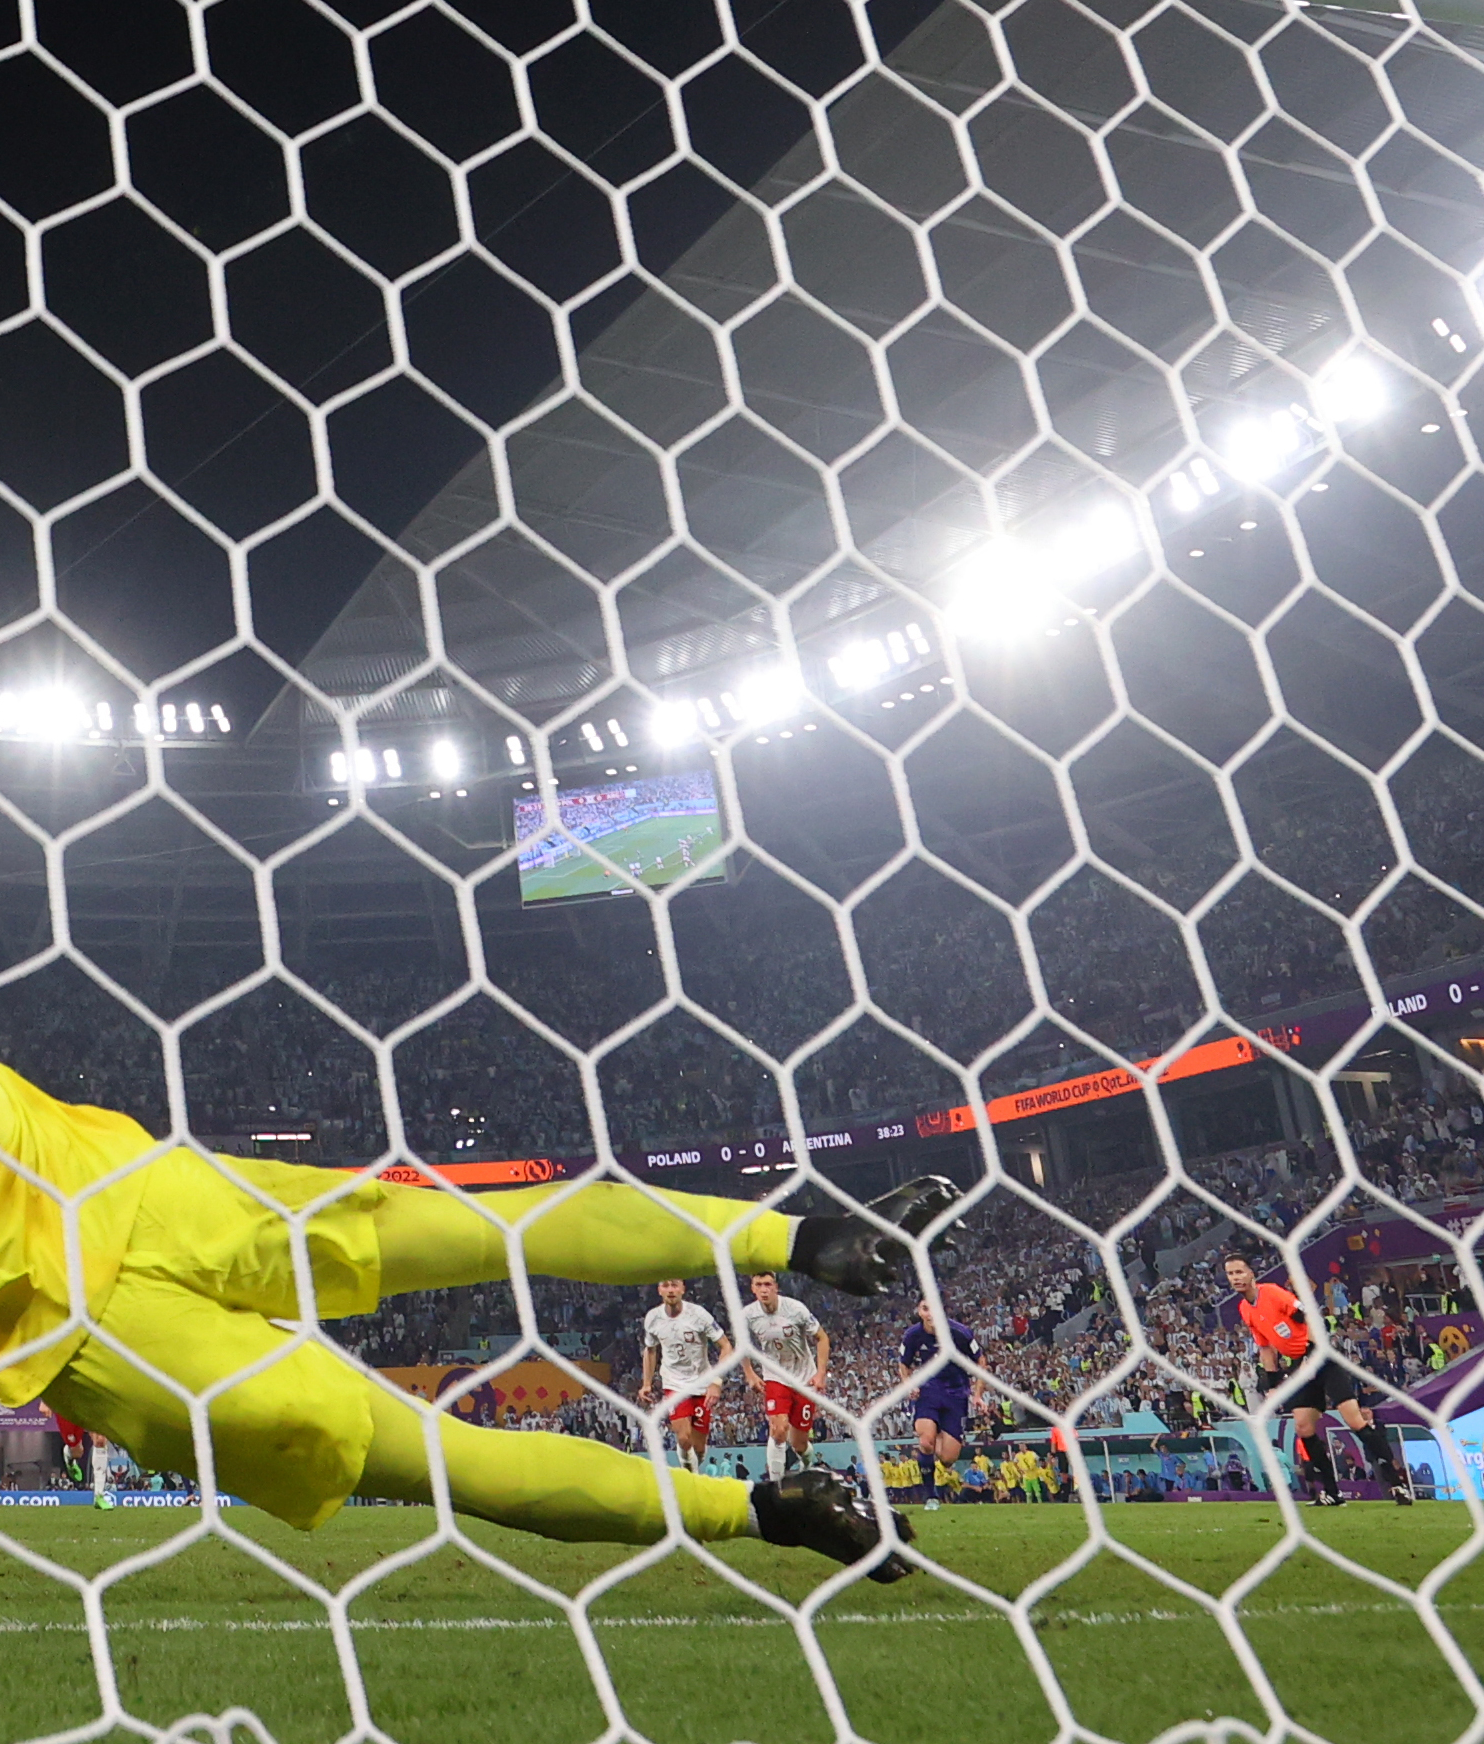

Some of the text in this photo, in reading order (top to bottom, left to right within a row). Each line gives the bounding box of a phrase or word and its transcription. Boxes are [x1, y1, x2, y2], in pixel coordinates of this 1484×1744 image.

[1449, 984, 1462, 1003] 0
[1036, 1087, 1071, 1108] WORLD
[1072, 1083, 1094, 1098] CUP
[647, 1151, 701, 1168] POLAND
[721, 1146, 732, 1161] 0
[754, 1143, 765, 1158] 0
[782, 1133, 853, 1153] ARENTINA
[877, 1125, 905, 1140] 38:23
[802, 1404, 811, 1420] 6
